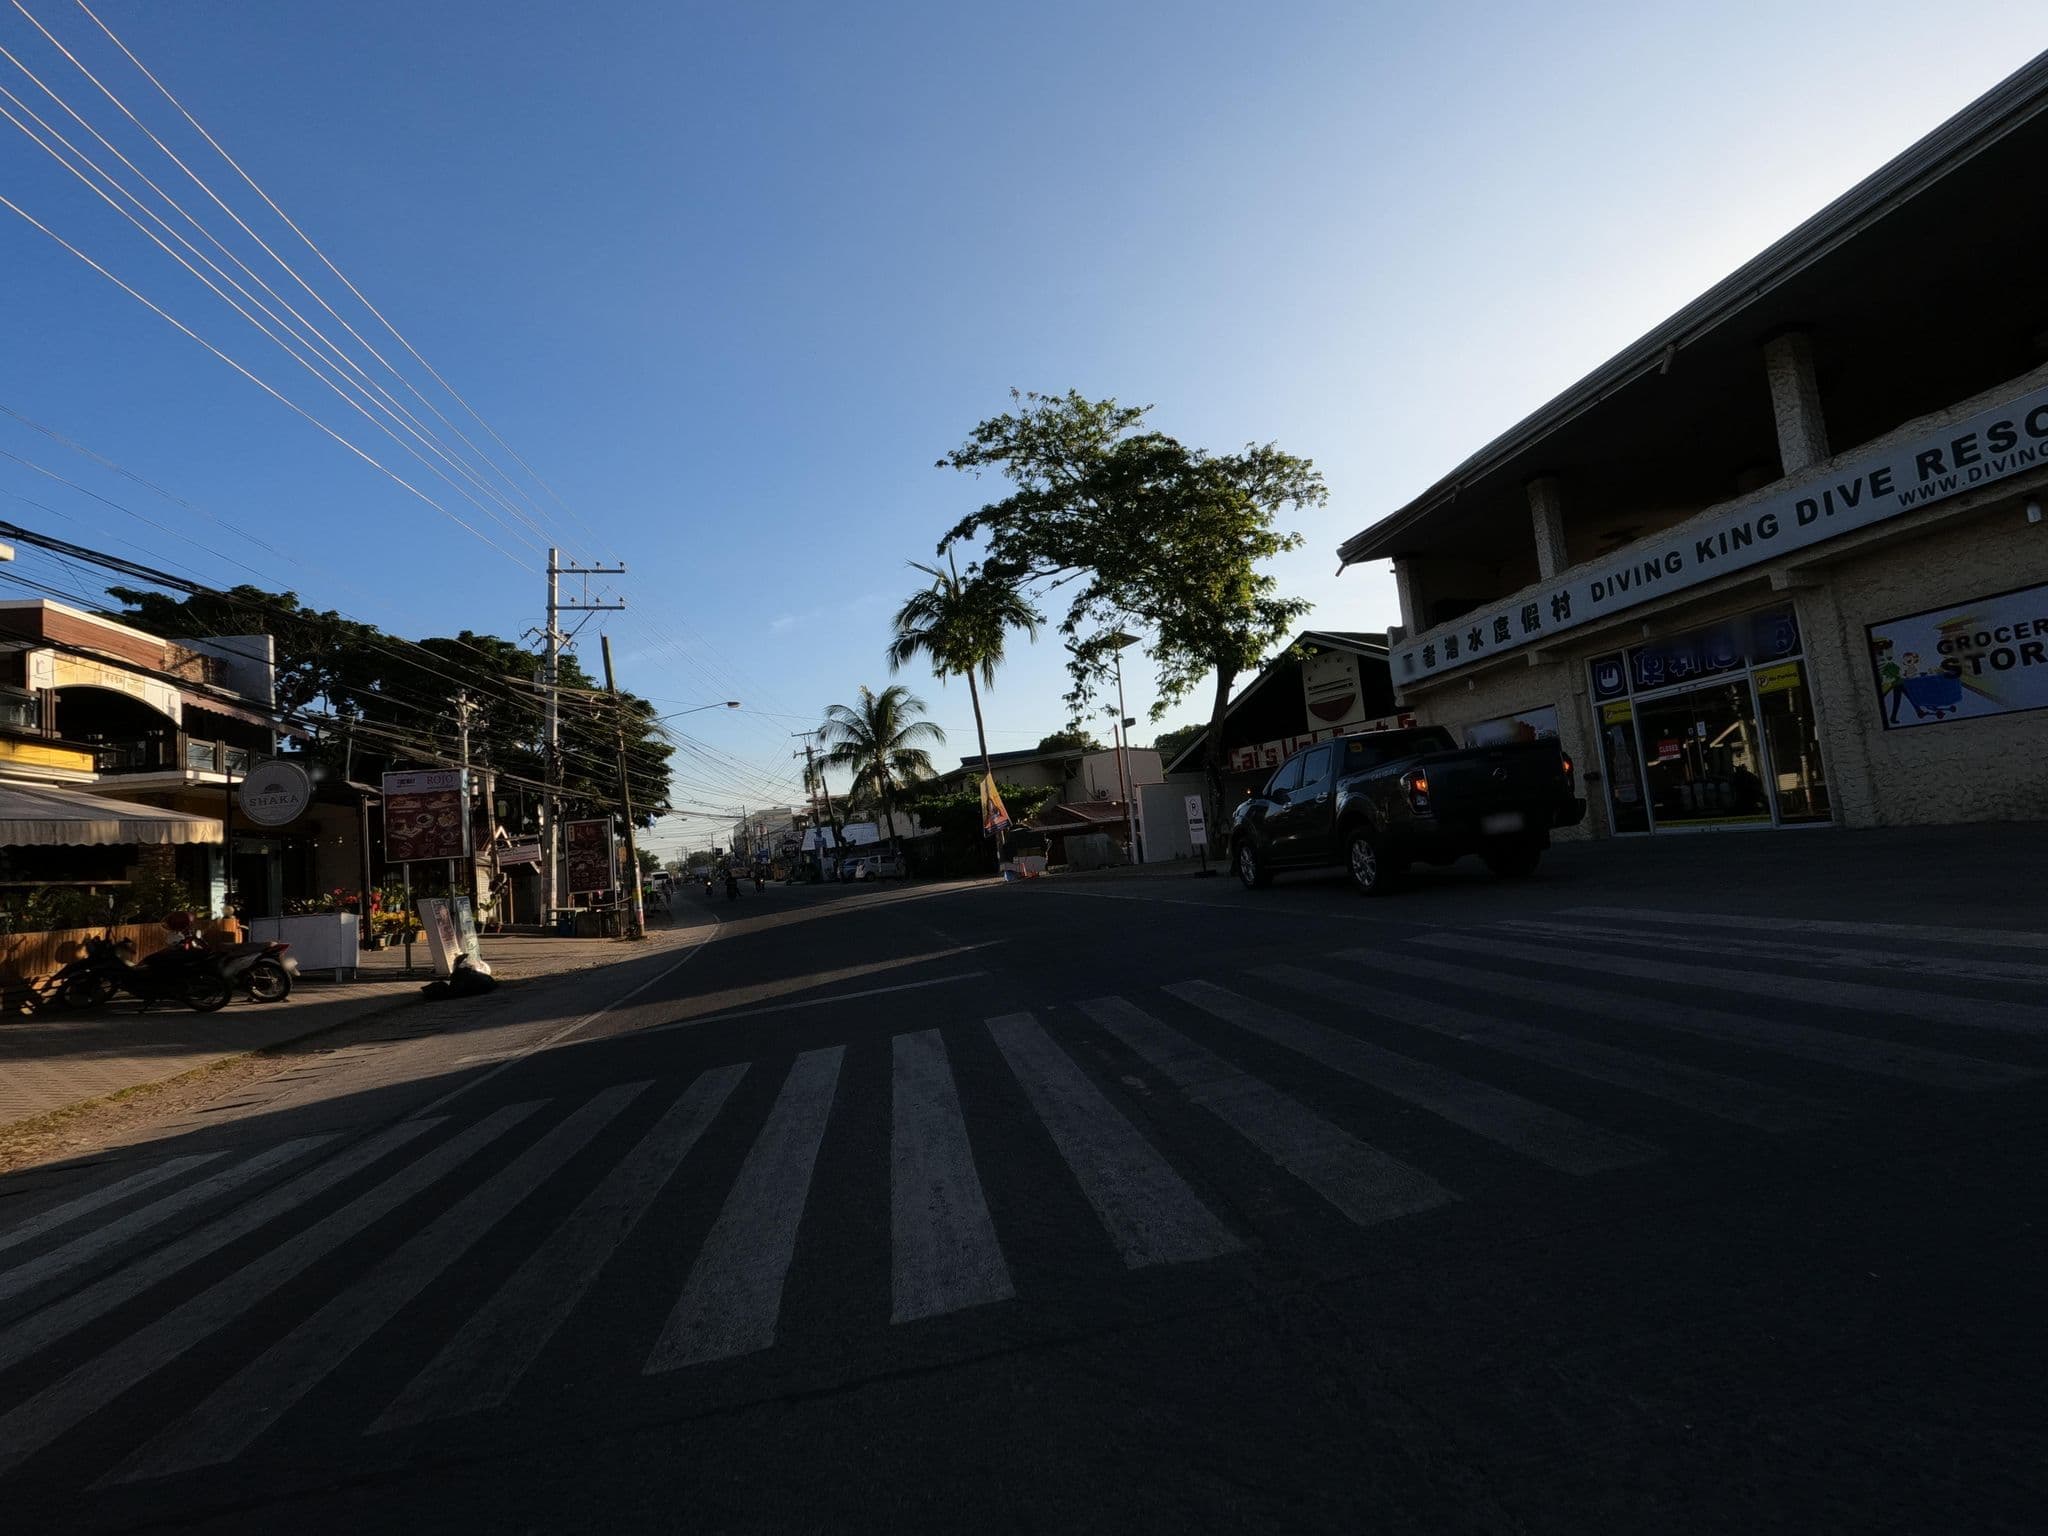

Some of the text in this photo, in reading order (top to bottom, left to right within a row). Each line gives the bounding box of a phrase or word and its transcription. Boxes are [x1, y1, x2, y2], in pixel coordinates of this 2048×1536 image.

[1590, 403, 2048, 602] DIVING KING DIVE RESO
[1403, 590, 1571, 677] 者水度假村
[1936, 618, 2048, 655] GROCER
[1941, 641, 2048, 679] STOR
[249, 794, 300, 807] SHAKA
